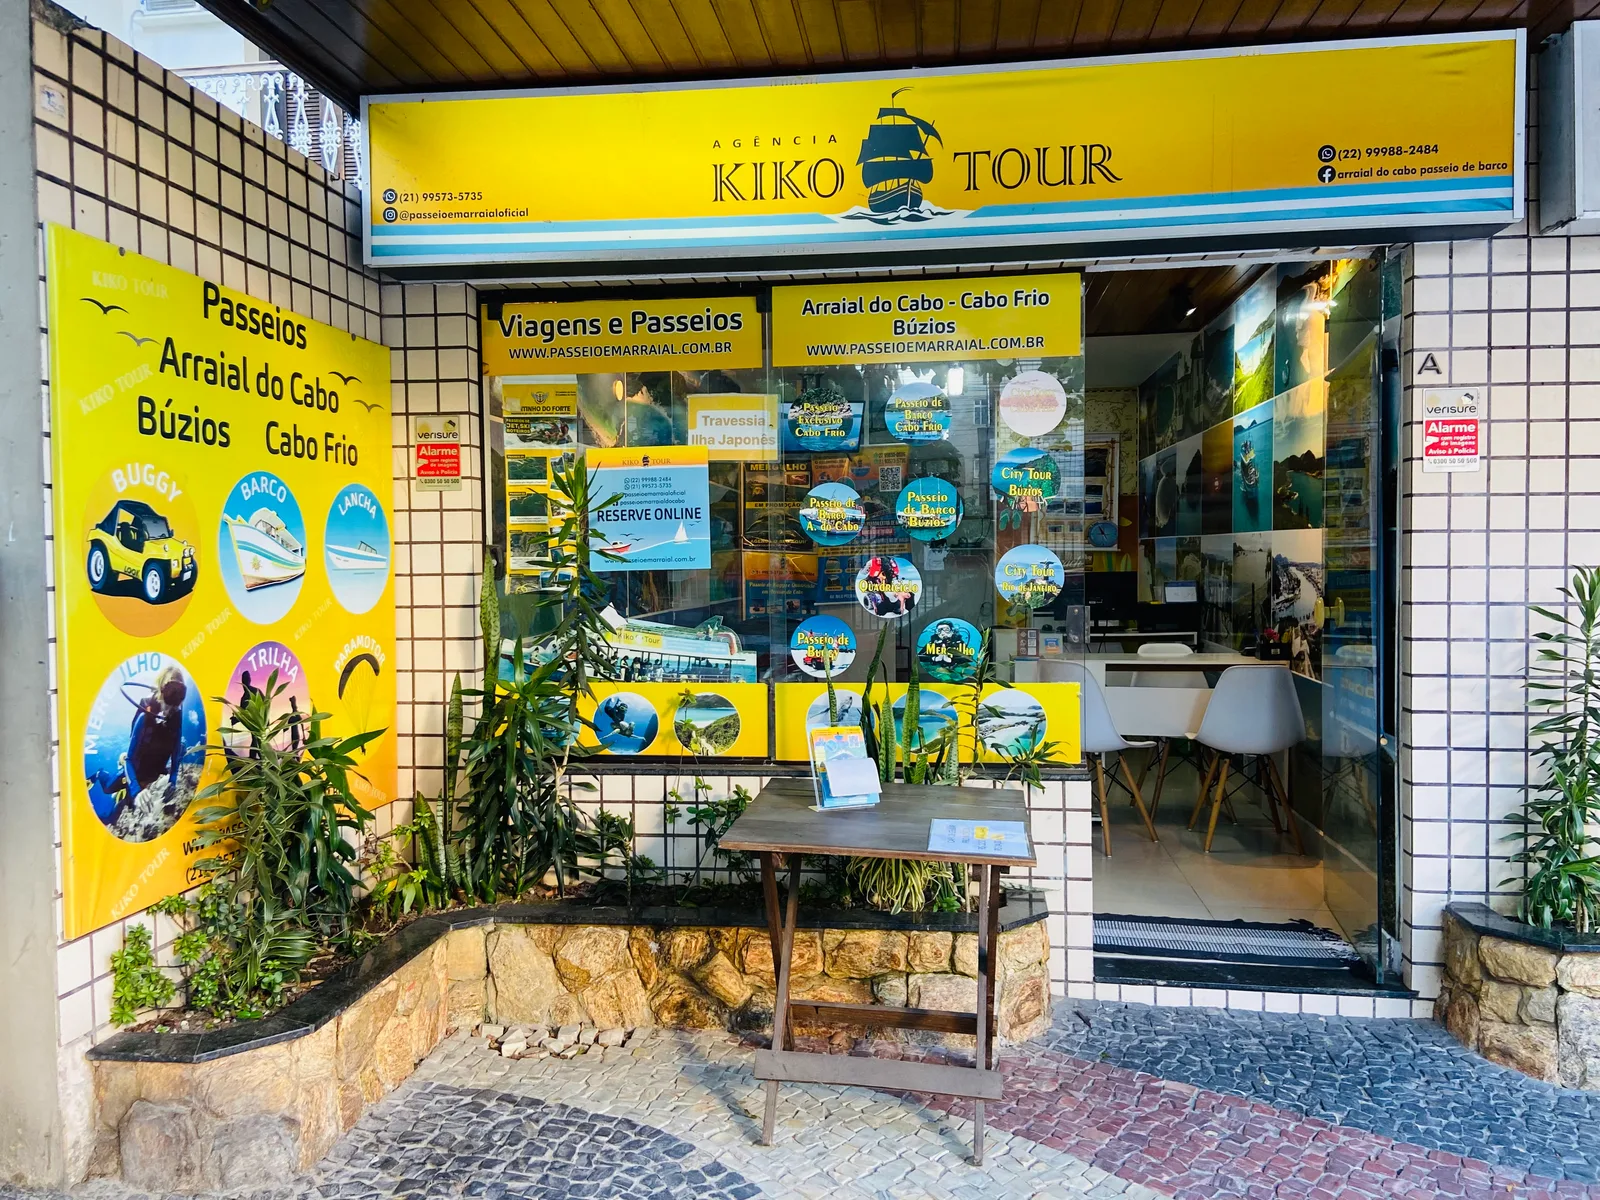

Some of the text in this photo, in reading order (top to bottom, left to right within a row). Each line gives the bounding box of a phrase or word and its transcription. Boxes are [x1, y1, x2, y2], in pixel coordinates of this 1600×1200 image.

[712, 134, 838, 149] AGÊNCIA
[1338, 144, 1439, 162] (22) 99988-2484
[712, 143, 1123, 202] KIKO TOUR
[1337, 160, 1508, 179] arraial do cabo passeio de barco
[399, 192, 483, 204] (21) 99573-5735
[399, 208, 529, 221] @passeioemarraialoficial
[92, 270, 169, 300] KIKO TOUR
[801, 296, 864, 316] Arraial
[869, 295, 893, 314] do
[897, 293, 944, 312] Cabo
[960, 290, 1008, 309] Cabo
[1014, 288, 1050, 307] Frio
[202, 281, 307, 350] Passeios
[498, 307, 743, 343] Viagens e Passeios
[892, 317, 957, 336] Búzios
[509, 341, 732, 359] WWW.PASSEIOEMARRAIAL.COM.BR
[806, 336, 1045, 356] WWW.PASSEIOEMARRAIAL.COM.BR
[1418, 353, 1442, 374] A
[159, 336, 340, 414] Arraial do Cabo
[79, 363, 154, 416] KIKO TOUR
[1427, 405, 1476, 414] verisure
[702, 415, 766, 427] Travessia
[1428, 421, 1476, 434] Alarme
[138, 395, 359, 467] Búzios Cabo Frio
[691, 434, 776, 447] Ilha Japonês
[419, 446, 458, 456] Alarme
[111, 462, 183, 503] BUGGY
[240, 475, 288, 504] BARCO
[623, 490, 687, 498] passeioemarraialoficial
[338, 492, 377, 519] LANCHA
[597, 507, 702, 522] RESERVE ONLINE
[645, 635, 660, 645] Tour
[334, 635, 386, 674] PARAMOTOR
[926, 643, 975, 658] Merlho
[247, 647, 299, 684] TRILHA
